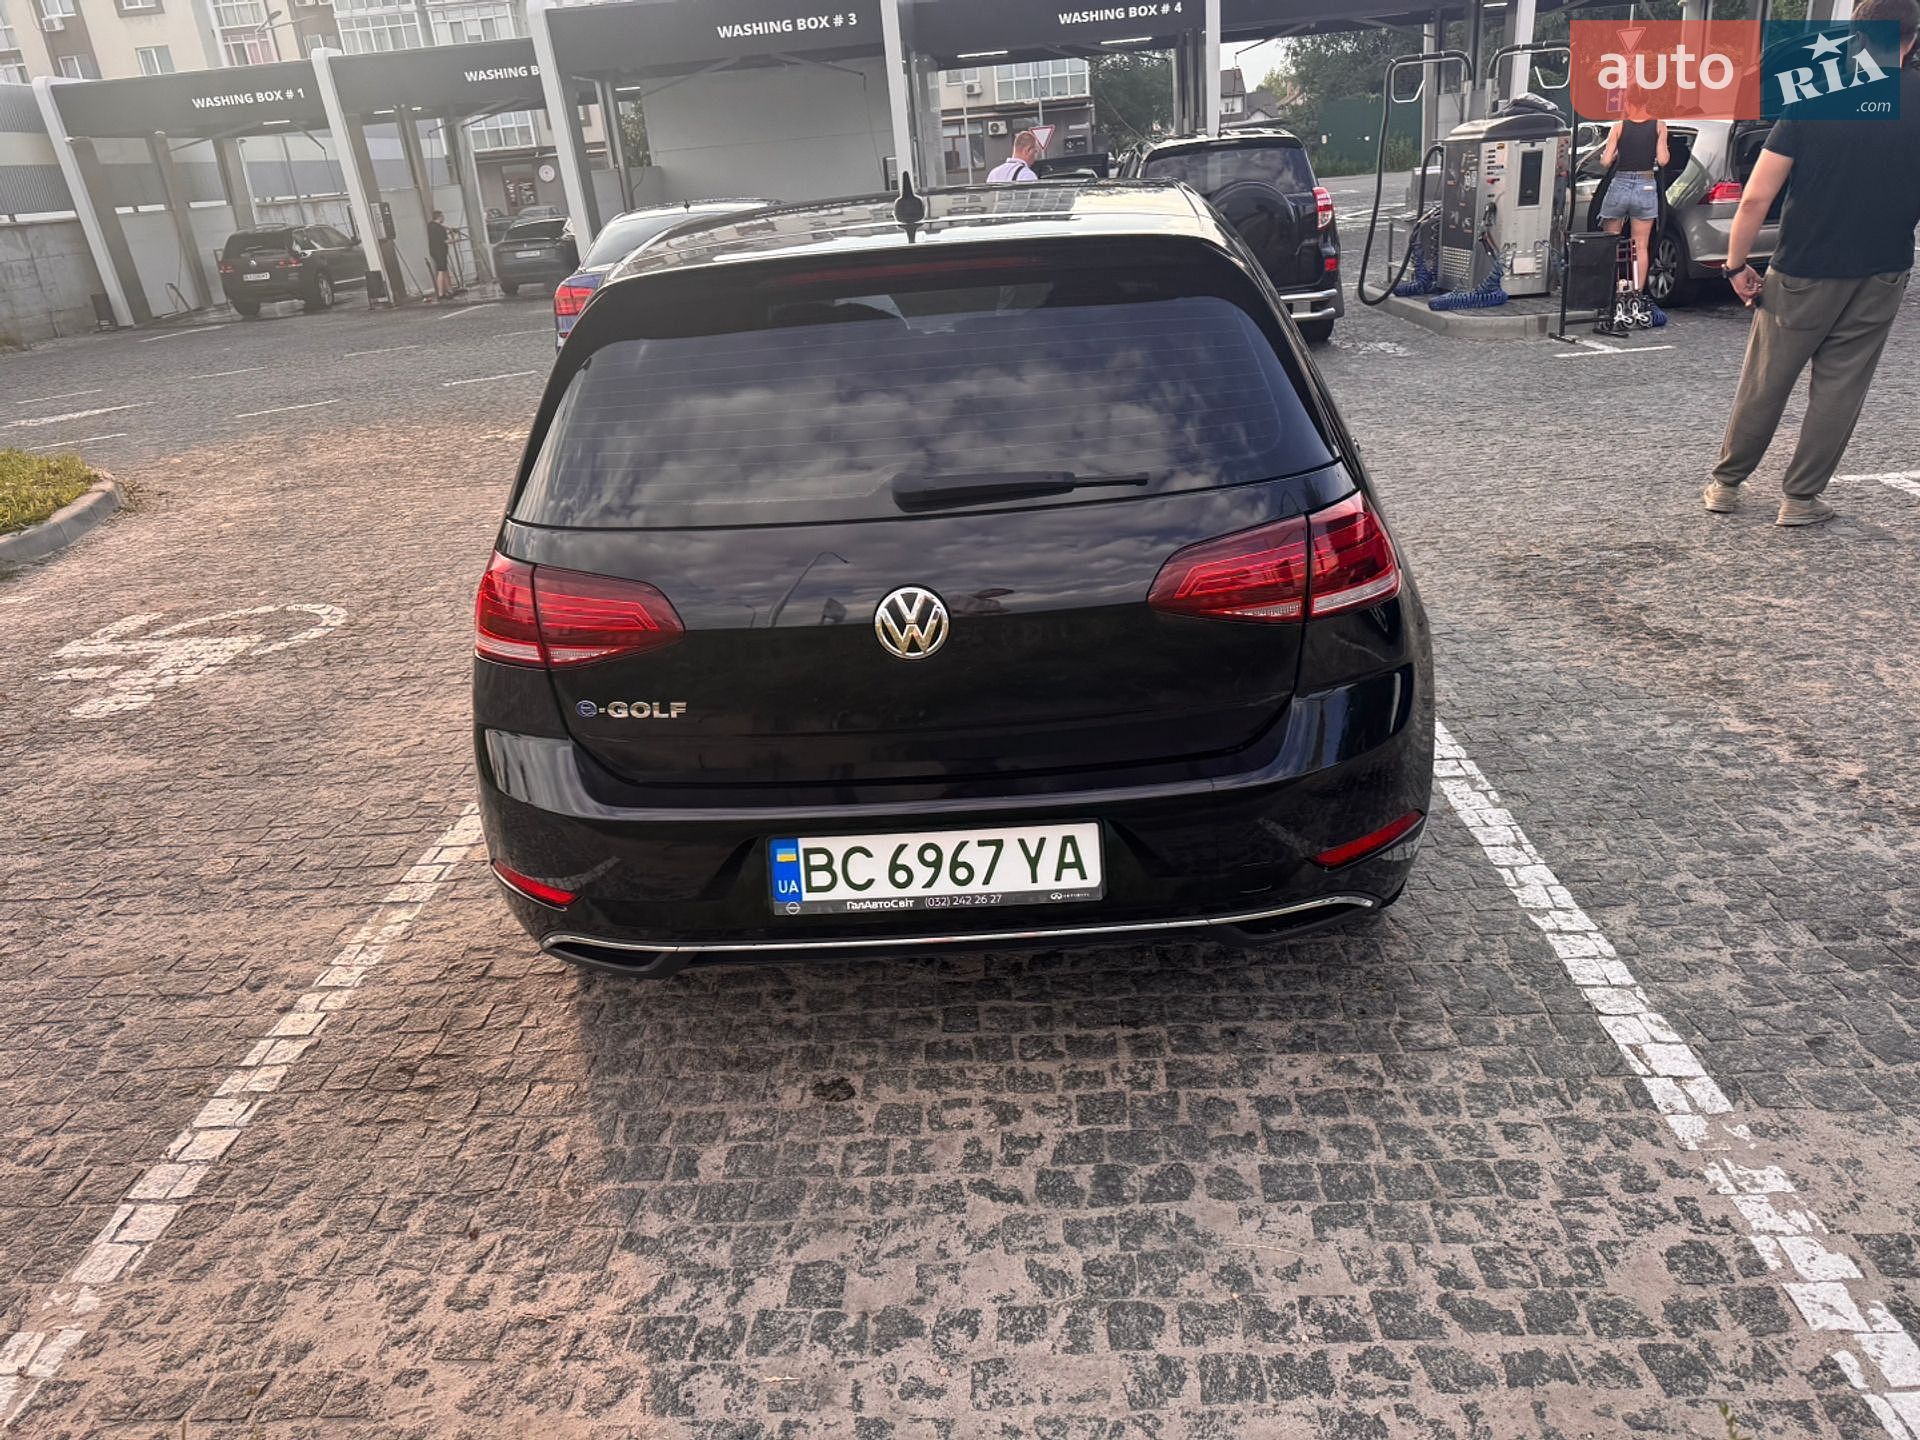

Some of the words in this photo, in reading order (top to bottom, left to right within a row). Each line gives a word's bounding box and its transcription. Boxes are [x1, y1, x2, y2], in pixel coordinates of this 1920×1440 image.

[1058, 8, 1125, 25] WASHING
[1128, 4, 1158, 18] BOX
[1160, 3, 1171, 15] #
[1174, 1, 1183, 13] 4
[716, 19, 793, 39] WASHING
[796, 15, 830, 31] BOX
[832, 14, 844, 27] #
[848, 12, 857, 26] 3
[464, 66, 529, 82] WASHING
[191, 93, 254, 109] WASHING
[255, 89, 284, 103] BOX
[285, 88, 294, 100] #
[297, 87, 305, 99] 1
[802, 846, 876, 893] BC
[887, 838, 1004, 890] 6967
[1017, 834, 1088, 884] YA
[778, 879, 799, 894] UA
[925, 897, 950, 908] (032)
[952, 896, 973, 906] 242
[975, 895, 988, 905] 26
[990, 894, 1002, 905] 27
